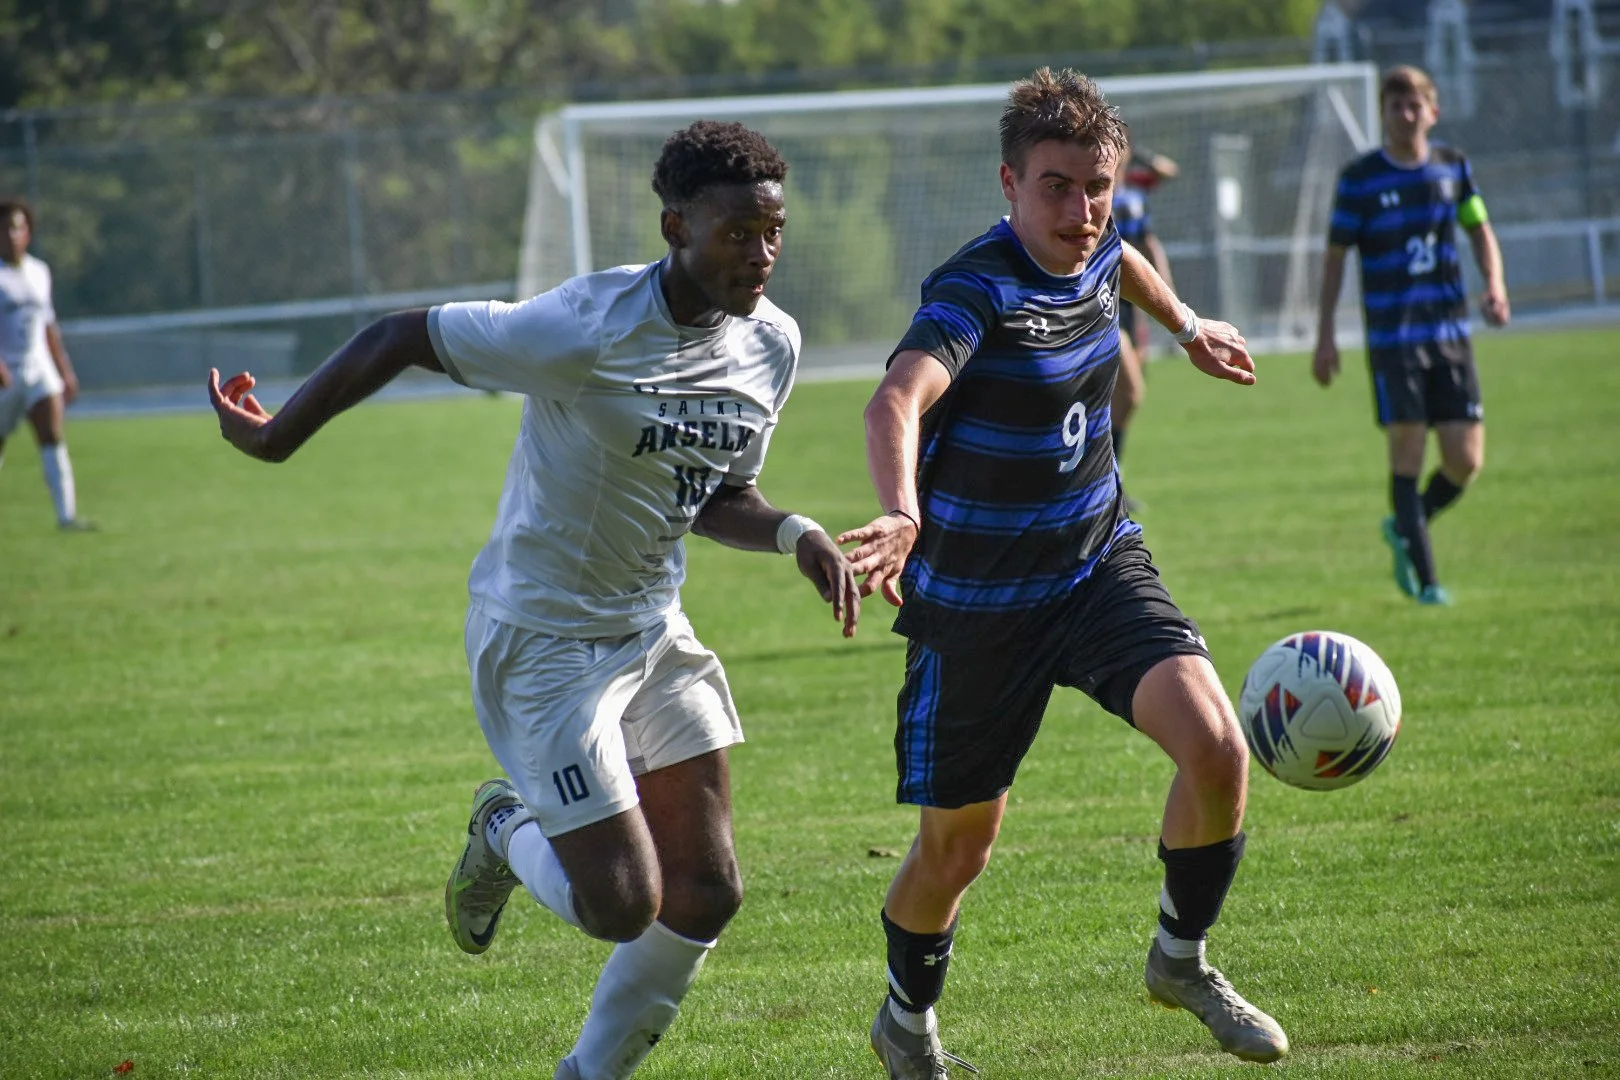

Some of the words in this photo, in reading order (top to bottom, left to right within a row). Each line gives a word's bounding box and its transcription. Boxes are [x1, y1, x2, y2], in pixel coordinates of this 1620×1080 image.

[658, 400, 743, 418] SAINT
[1058, 401, 1087, 473] 9
[552, 763, 590, 807] 10
